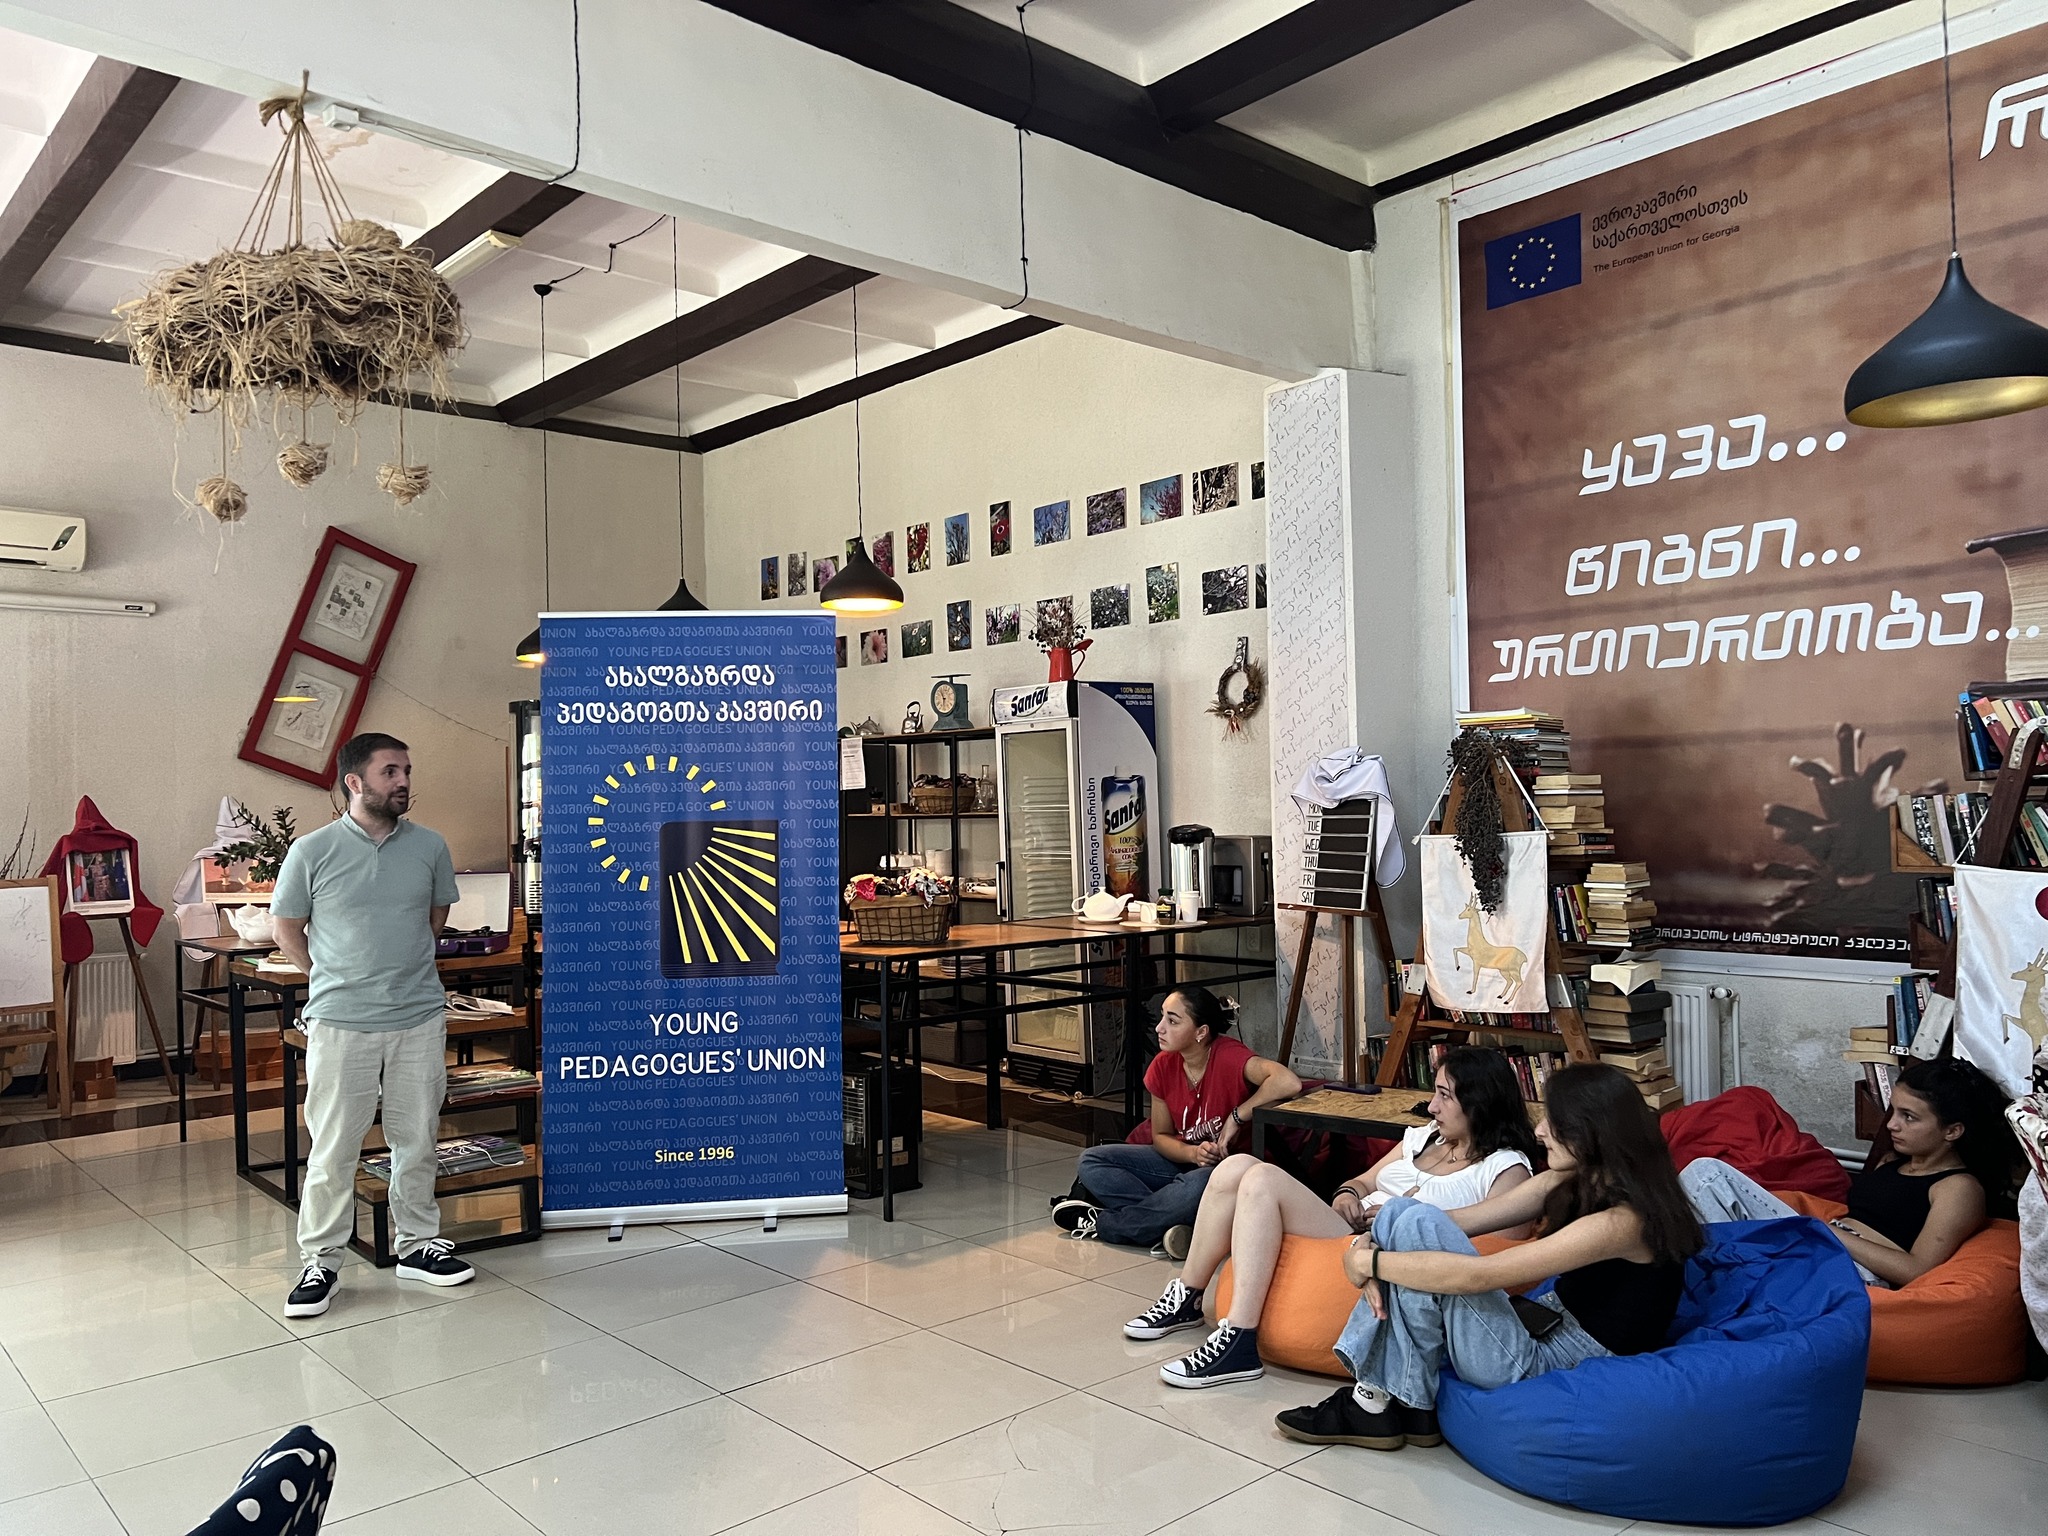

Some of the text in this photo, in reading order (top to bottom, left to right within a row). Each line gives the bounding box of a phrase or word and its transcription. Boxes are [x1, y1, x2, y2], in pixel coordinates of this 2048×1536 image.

[1592, 184, 1697, 232] ევროკავშირი
[1592, 189, 1748, 249] საქართველოსთვის
[1593, 224, 1740, 273] The European Union for Georgia
[802, 626, 835, 636] YOUN
[780, 645, 835, 655] ახალგაზ
[803, 664, 835, 674] YOUN
[605, 664, 775, 687] ახალგაზრდა
[781, 683, 836, 694] ახალგაზ
[556, 699, 823, 724] პედაგოგთა კავშირი
[781, 722, 836, 732] ახალგაზ
[804, 741, 837, 751] YOUN
[782, 760, 837, 771] ახალგაზ
[804, 779, 837, 790] YOUN
[782, 799, 838, 810] ახალგაზ
[805, 818, 838, 828] YOUN
[1308, 820, 1320, 832] TUE
[783, 837, 838, 848] ახალგაზ
[1305, 838, 1320, 850] WED
[805, 857, 838, 867] YOUN
[1304, 856, 1318, 868] THU
[783, 876, 839, 887] ახალგაზ
[1303, 874, 1315, 885] FRI
[806, 896, 839, 906] YOUN
[1301, 890, 1314, 903] SAT
[784, 915, 839, 926] ახალგაზ
[807, 934, 840, 945] YOUN
[1733, 932, 1840, 947] სტრატეგიული
[784, 954, 840, 966] ახალგაზ
[807, 973, 840, 984] YOUN
[785, 993, 841, 1005] ახალგაზ
[649, 1011, 739, 1036] YOUNG
[808, 1013, 841, 1024] YOUN
[785, 1032, 841, 1044] ახალგაზ
[560, 1046, 825, 1079] PEDAGOGUES' UNION
[786, 1071, 842, 1084] ახალგაზ
[809, 1091, 842, 1103] YOUN
[786, 1111, 842, 1123] ახალგაზ
[809, 1131, 843, 1142] YOUN
[655, 1146, 734, 1163] Since 1996
[787, 1150, 843, 1163] ახალგაზ
[810, 1170, 843, 1182] YOUN
